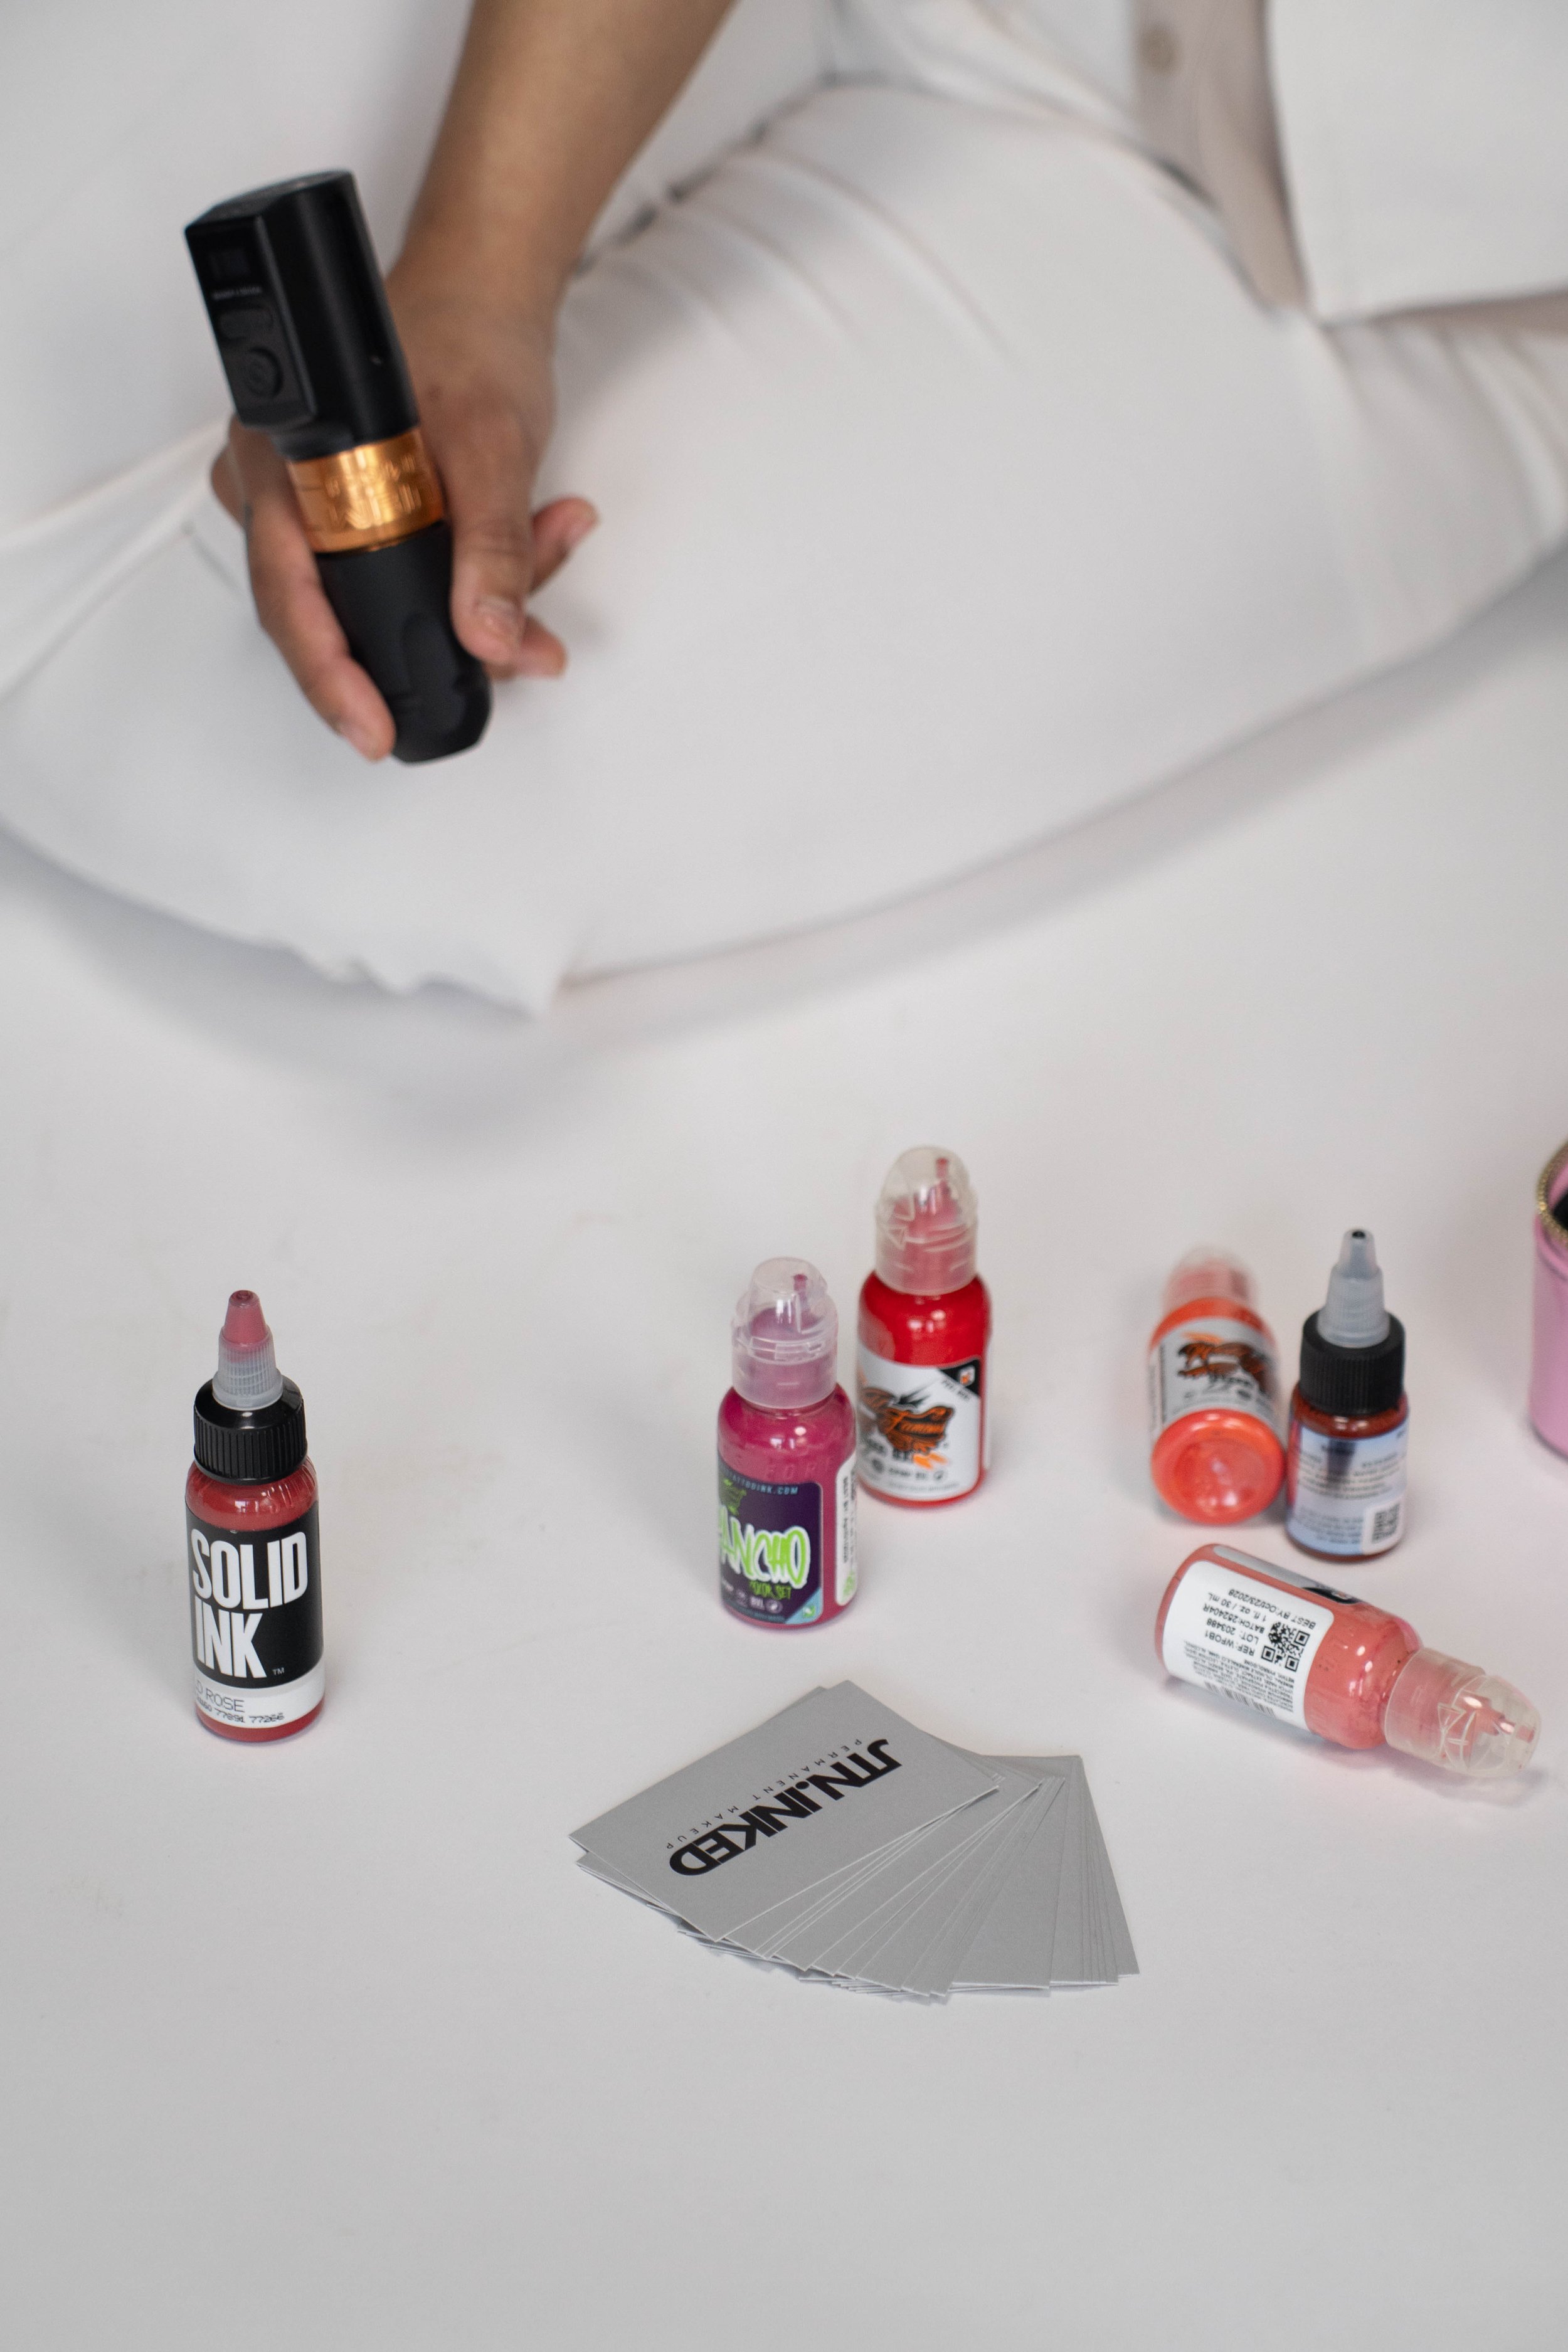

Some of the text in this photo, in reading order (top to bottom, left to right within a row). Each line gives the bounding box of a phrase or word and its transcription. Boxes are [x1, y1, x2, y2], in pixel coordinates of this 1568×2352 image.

[191, 1528, 308, 1610] SOLID
[1207, 1592, 1220, 1601] mL
[1220, 1597, 1232, 1608] 30
[1205, 1617, 1259, 1645] LOT: 203488
[1293, 1614, 1316, 1629] BEST
[194, 1594, 267, 1678] INK
[1234, 1641, 1256, 1656] REF:
[206, 1687, 246, 1713] ROSE
[666, 1739, 862, 1850] PERMANENT MAKEUP
